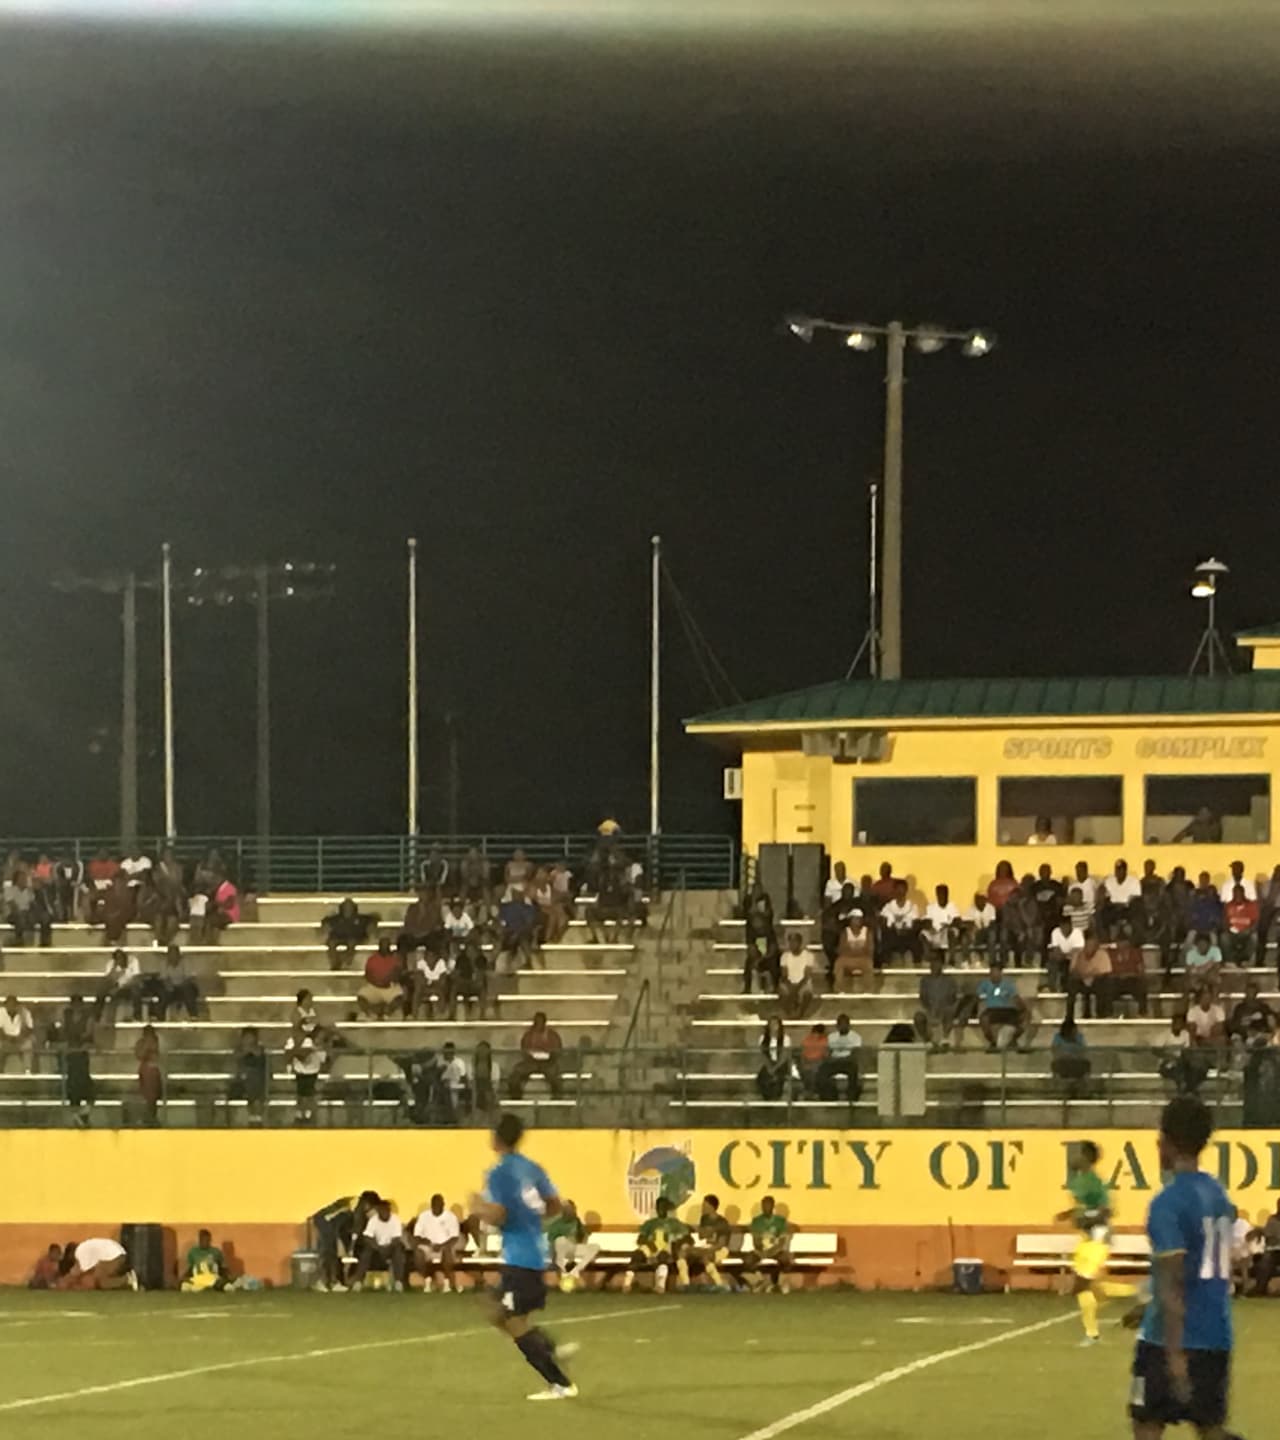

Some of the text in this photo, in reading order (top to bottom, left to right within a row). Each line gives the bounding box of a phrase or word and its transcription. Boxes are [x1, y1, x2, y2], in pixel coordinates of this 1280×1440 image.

[1003, 735, 1269, 760] SPORTS COMPLEX
[717, 1139, 892, 1190] CITY
[928, 1139, 1024, 1190] OF
